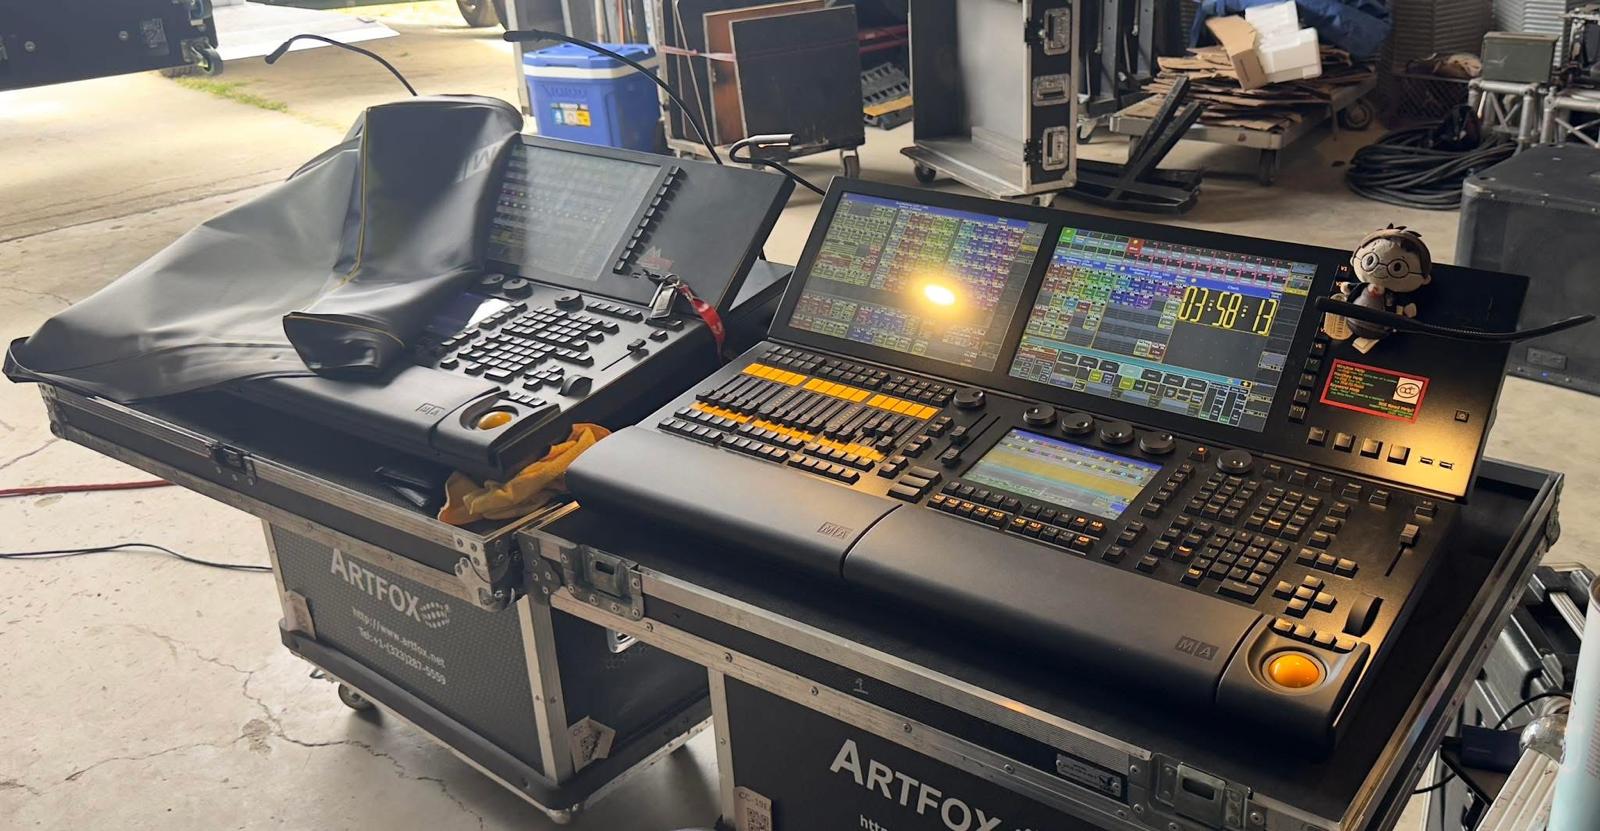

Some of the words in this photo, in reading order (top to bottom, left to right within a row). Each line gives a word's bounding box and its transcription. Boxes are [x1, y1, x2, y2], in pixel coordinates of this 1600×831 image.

[331, 548, 421, 622] ARTFOX
[830, 738, 1002, 831] ARTFOX
[860, 814, 889, 831] htt
